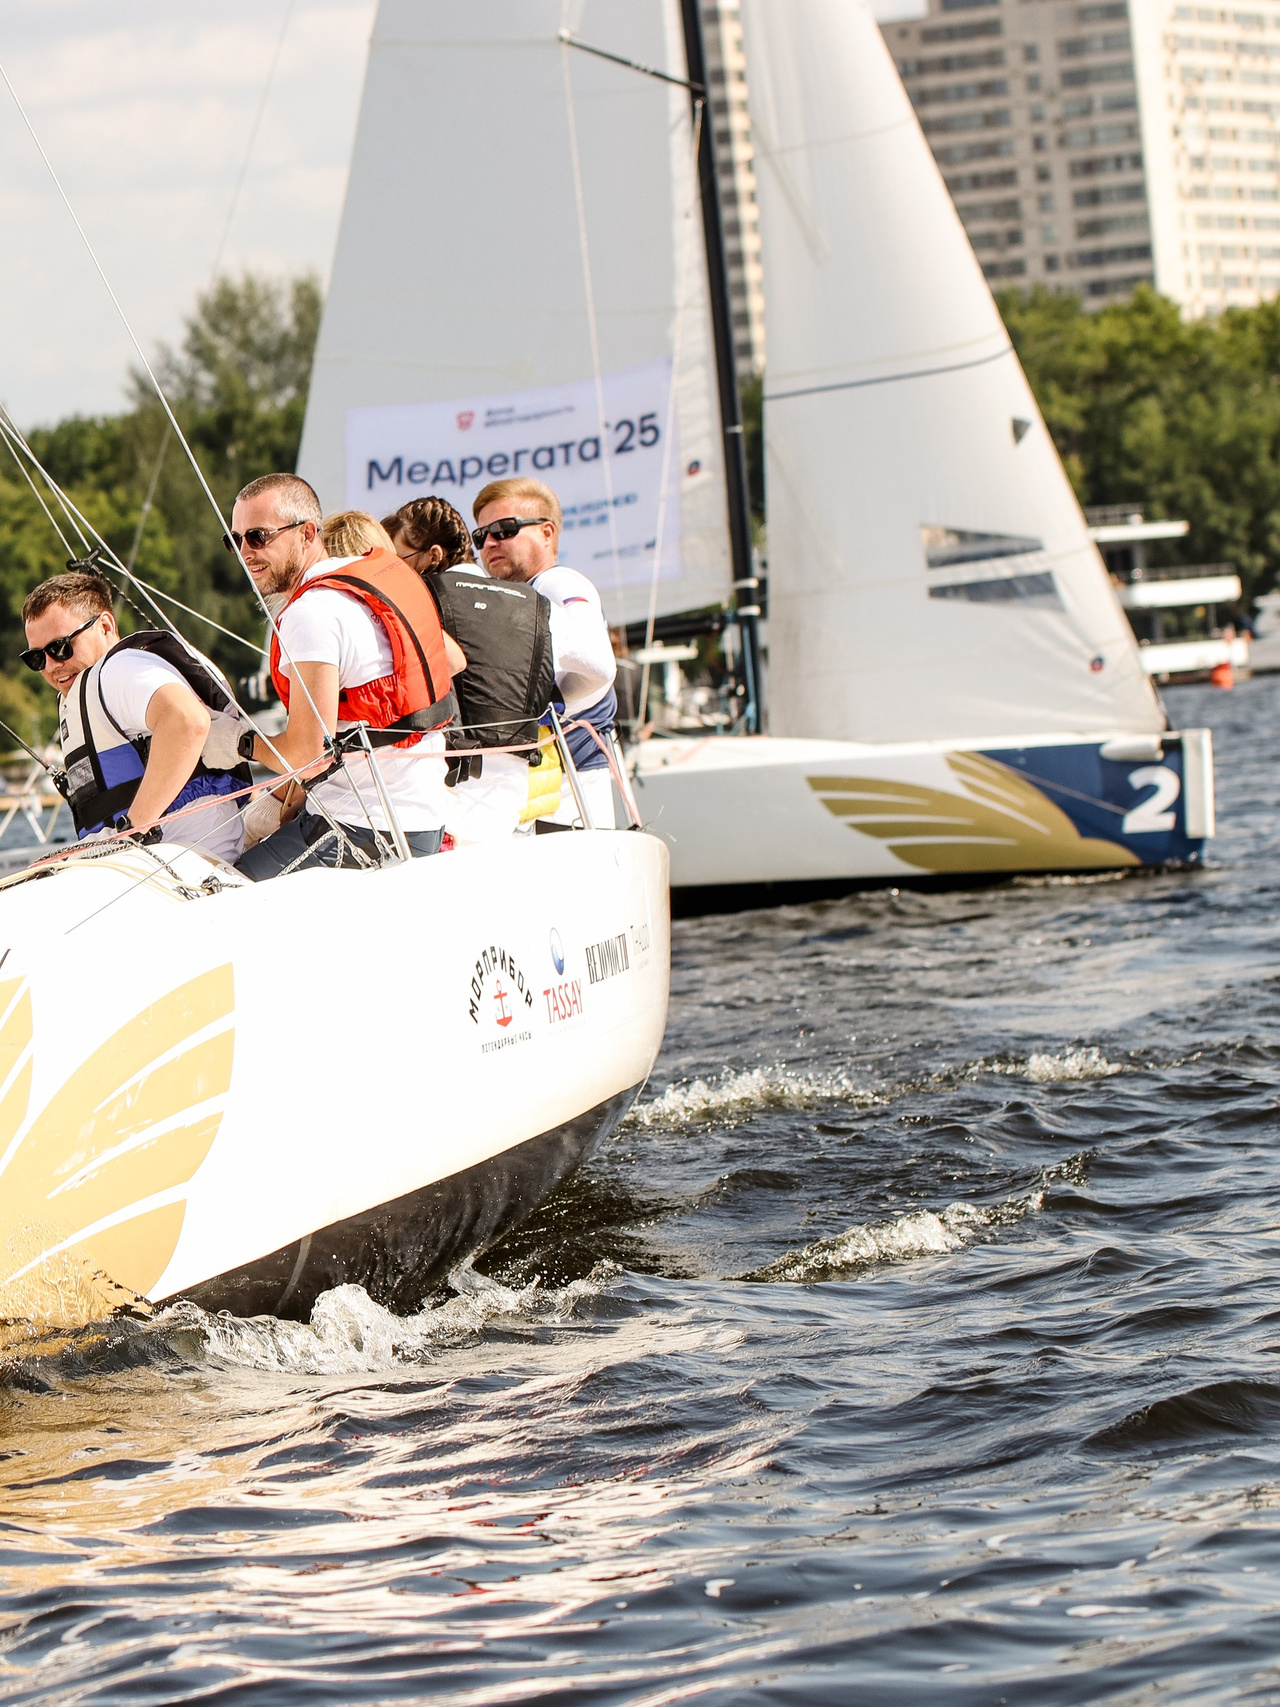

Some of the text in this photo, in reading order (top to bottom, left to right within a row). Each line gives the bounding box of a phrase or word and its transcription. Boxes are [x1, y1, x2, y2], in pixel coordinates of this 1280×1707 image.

[1122, 766, 1181, 834] 2
[469, 945, 533, 1025] МОРПРИБОР
[543, 978, 583, 1024] TASSAY
